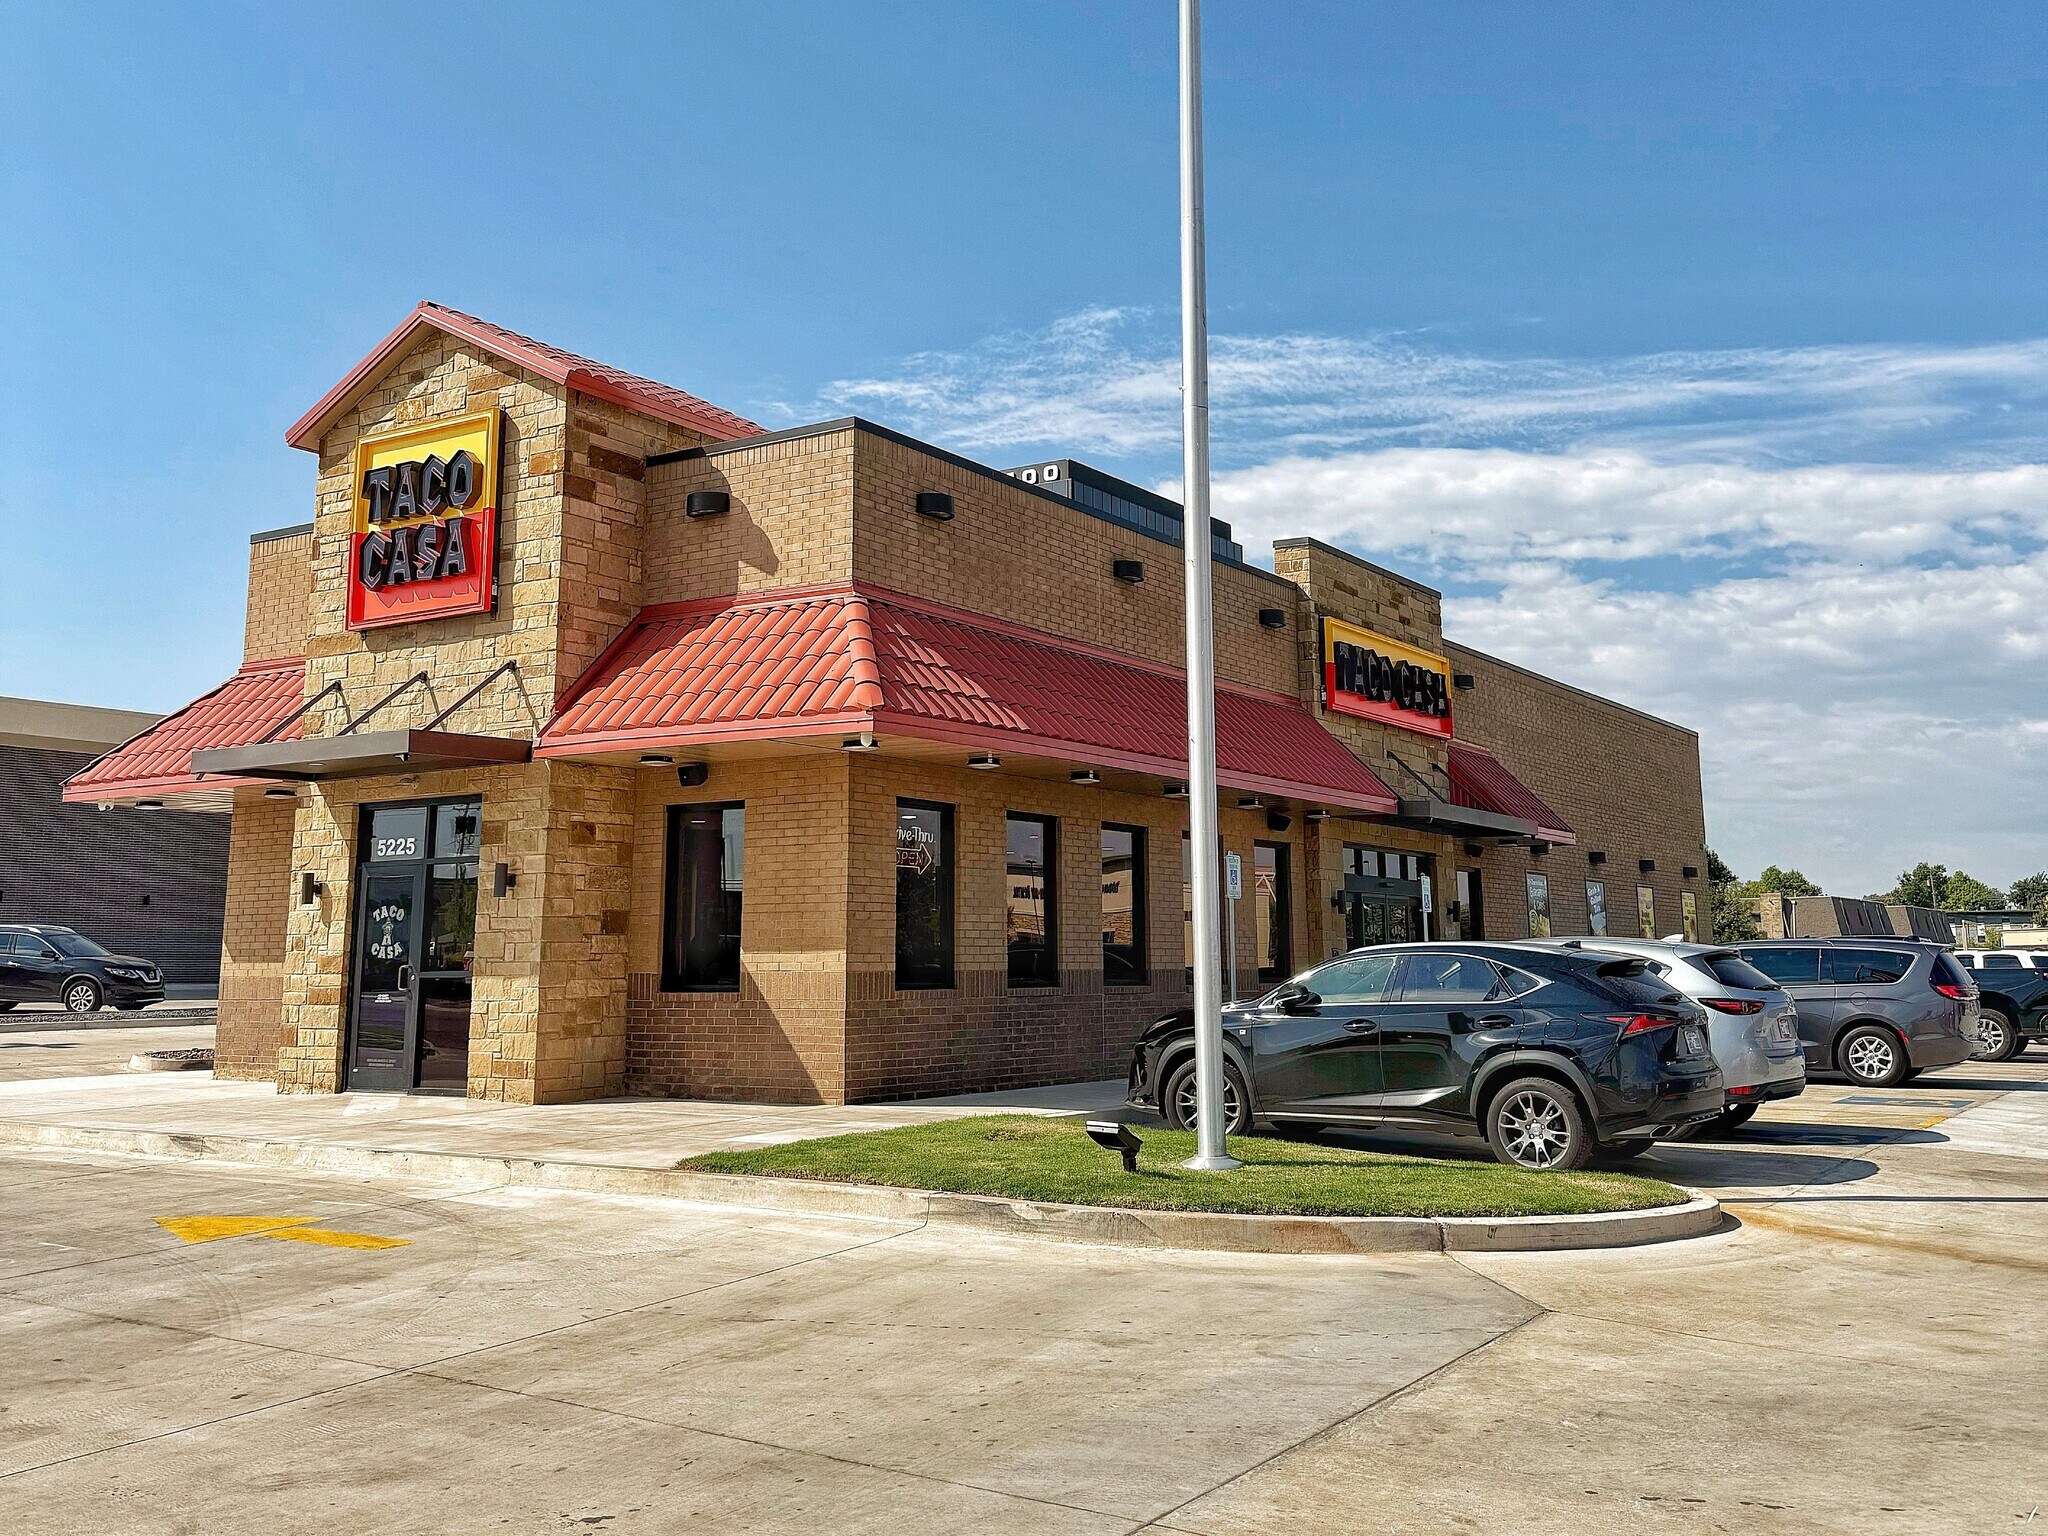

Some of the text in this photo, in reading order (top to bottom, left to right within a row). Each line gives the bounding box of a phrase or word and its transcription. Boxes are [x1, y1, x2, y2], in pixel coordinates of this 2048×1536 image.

[1006, 464, 1059, 485] 00
[361, 449, 483, 524] TACO
[359, 517, 472, 592] CASA
[1333, 640, 1395, 703] TACO
[376, 837, 416, 857] 5225
[372, 904, 405, 922] TACO
[371, 941, 404, 959] CASA
